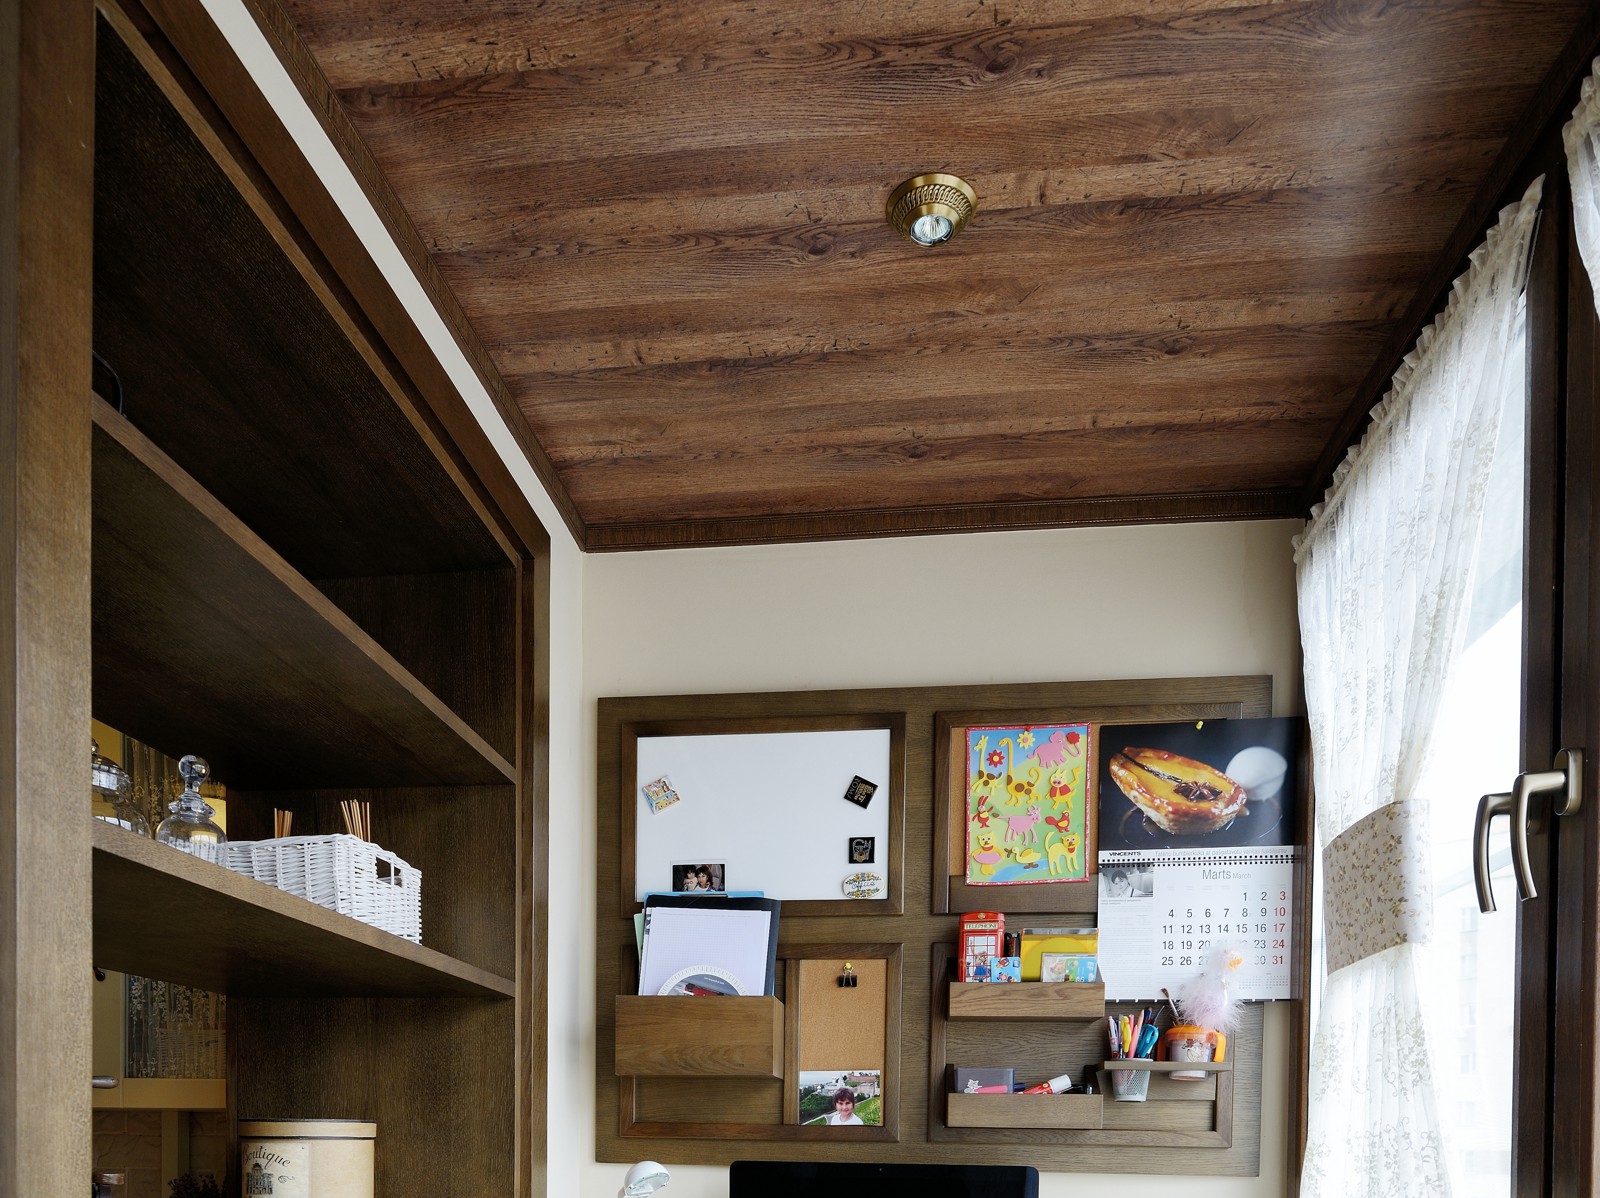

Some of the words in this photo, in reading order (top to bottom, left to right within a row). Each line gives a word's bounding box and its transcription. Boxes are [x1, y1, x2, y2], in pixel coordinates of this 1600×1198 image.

[1202, 869, 1232, 880] Marts
[1242, 892, 1247, 901] 1
[1261, 892, 1267, 901] 2
[1279, 891, 1286, 901] 3
[1168, 909, 1174, 918] 4
[1186, 908, 1193, 918] 5
[1204, 908, 1211, 918] 6
[1223, 908, 1230, 917] 7
[1242, 908, 1248, 917] 8
[1260, 907, 1267, 917] 9
[1273, 907, 1286, 917] 10
[1162, 925, 1174, 934] 11
[1181, 924, 1193, 934] 12
[1199, 924, 1211, 934] 13
[1217, 924, 1229, 933] 14
[1236, 923, 1248, 933] 15
[1254, 923, 1267, 933] 16
[1273, 923, 1286, 932] 17
[1162, 940, 1174, 950] 18
[1180, 940, 1193, 950] 19
[1198, 940, 1211, 950] 20
[1254, 939, 1266, 949] 23
[1272, 939, 1285, 949] 24
[1161, 956, 1174, 966] 25
[1180, 956, 1192, 966] 26
[1254, 955, 1266, 965] 30
[1272, 955, 1284, 965] 31
